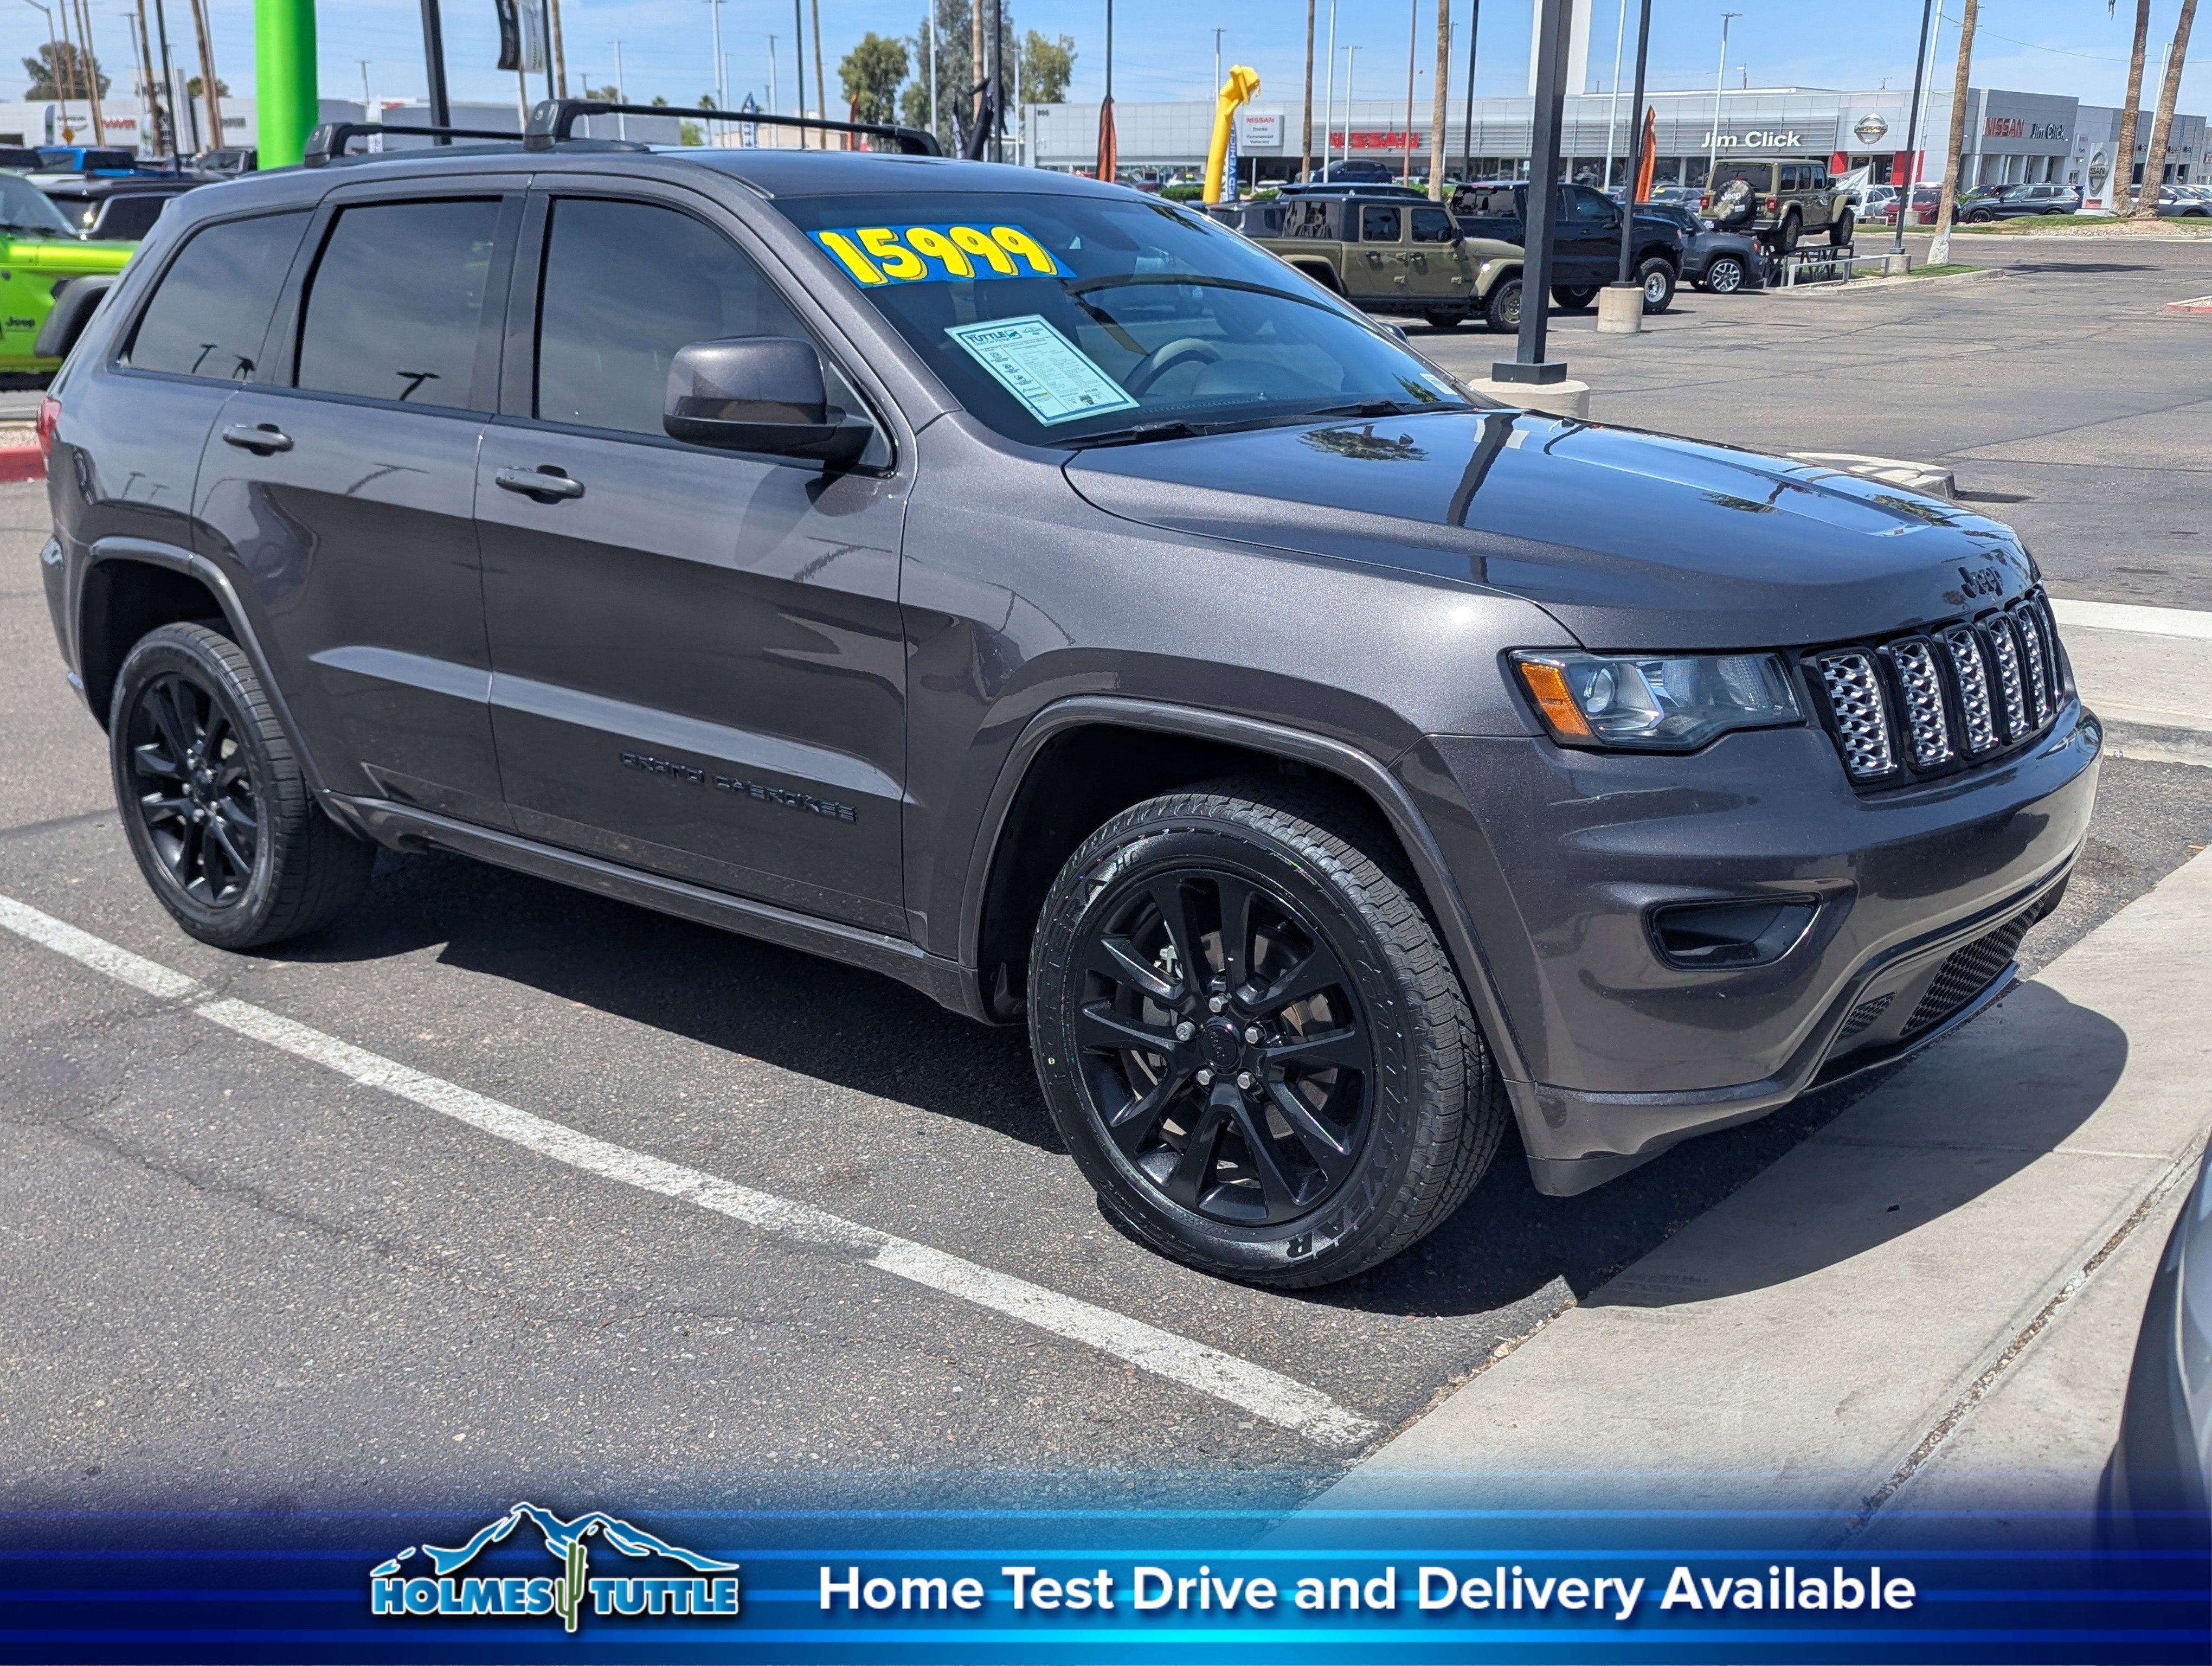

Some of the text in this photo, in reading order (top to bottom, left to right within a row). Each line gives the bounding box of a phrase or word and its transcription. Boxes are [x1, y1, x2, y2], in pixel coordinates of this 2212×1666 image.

[1982, 117, 2067, 140] NISSAN Jim Click
[1329, 131, 1419, 150] NSSAN
[1701, 131, 1801, 148] Jim Click
[1721, 191, 1741, 201] Jeep
[819, 226, 1058, 284] 15999
[967, 331, 1007, 343] TUTTLE
[1957, 567, 2003, 598] Jeep
[620, 751, 858, 823] GRAND CHEROKEE
